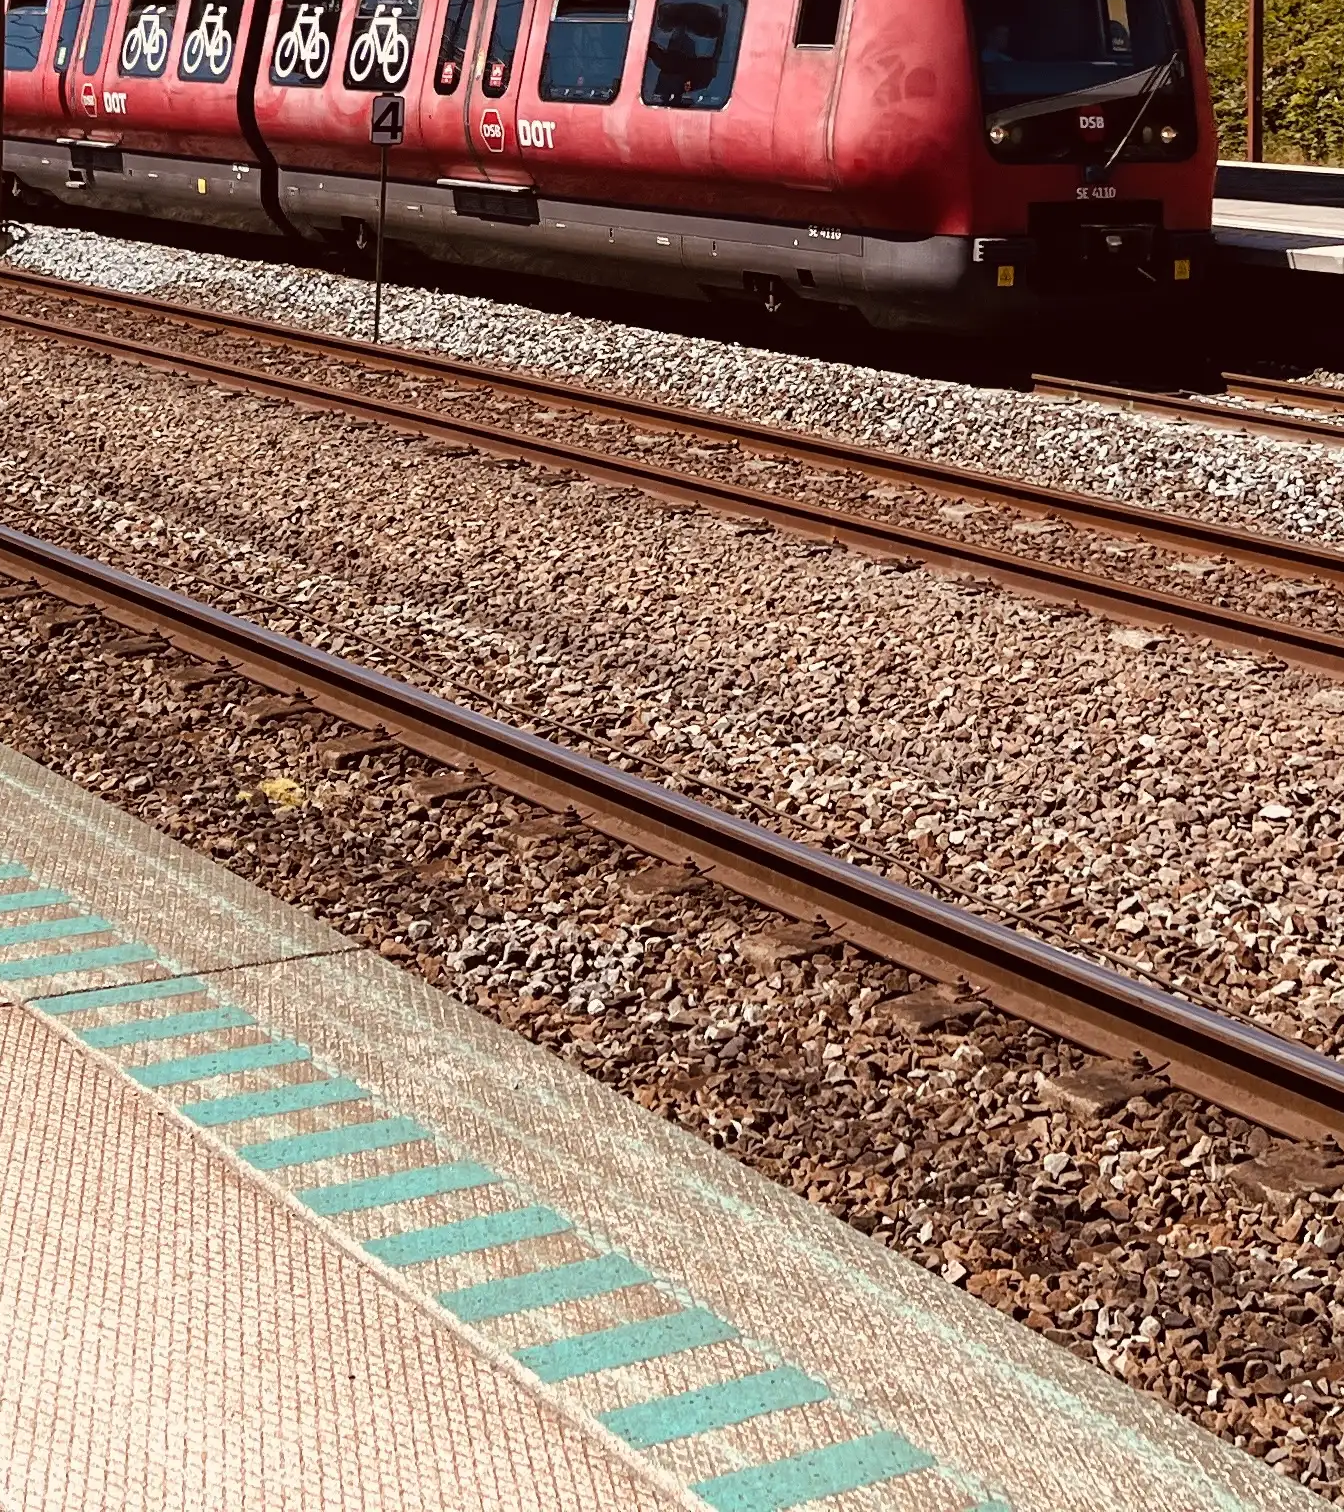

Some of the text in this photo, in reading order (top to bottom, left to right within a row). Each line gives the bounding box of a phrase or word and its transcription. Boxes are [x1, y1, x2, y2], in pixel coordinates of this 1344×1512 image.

[103, 91, 127, 114] DOT
[372, 101, 403, 139] 4
[1079, 116, 1105, 129] DSB
[482, 124, 502, 138] DSB
[517, 120, 556, 149] DOT
[1076, 187, 1117, 200] SE 4110
